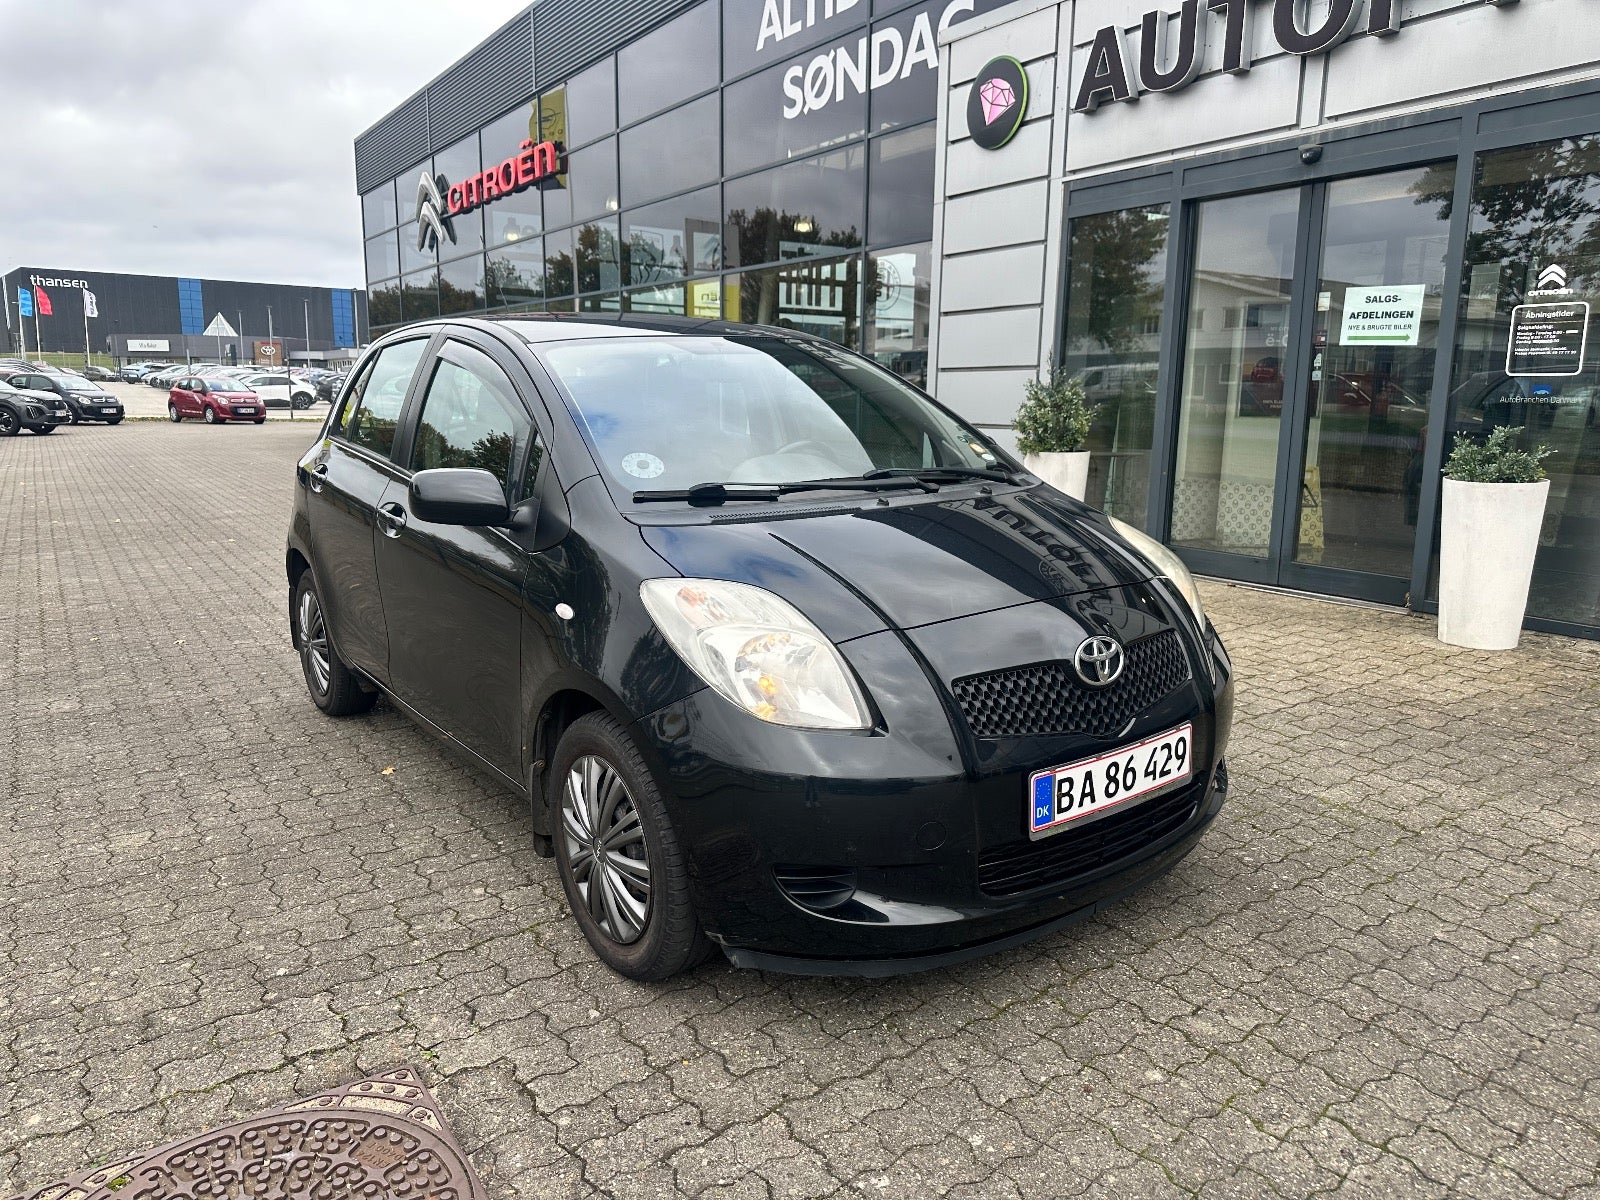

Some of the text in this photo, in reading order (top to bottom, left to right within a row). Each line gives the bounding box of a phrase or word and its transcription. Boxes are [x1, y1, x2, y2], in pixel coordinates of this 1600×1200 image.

[756, 0, 861, 51] ALT
[447, 137, 556, 214] CITROËN
[30, 274, 88, 288] thansen
[1365, 294, 1402, 304] SALGS-
[1349, 310, 1414, 320] AFDELINGEN
[1525, 310, 1575, 319] Åbningstider
[1500, 395, 1549, 404] AutoBranchen
[1056, 736, 1187, 815] BA 86 429
[1036, 805, 1050, 819] DK
